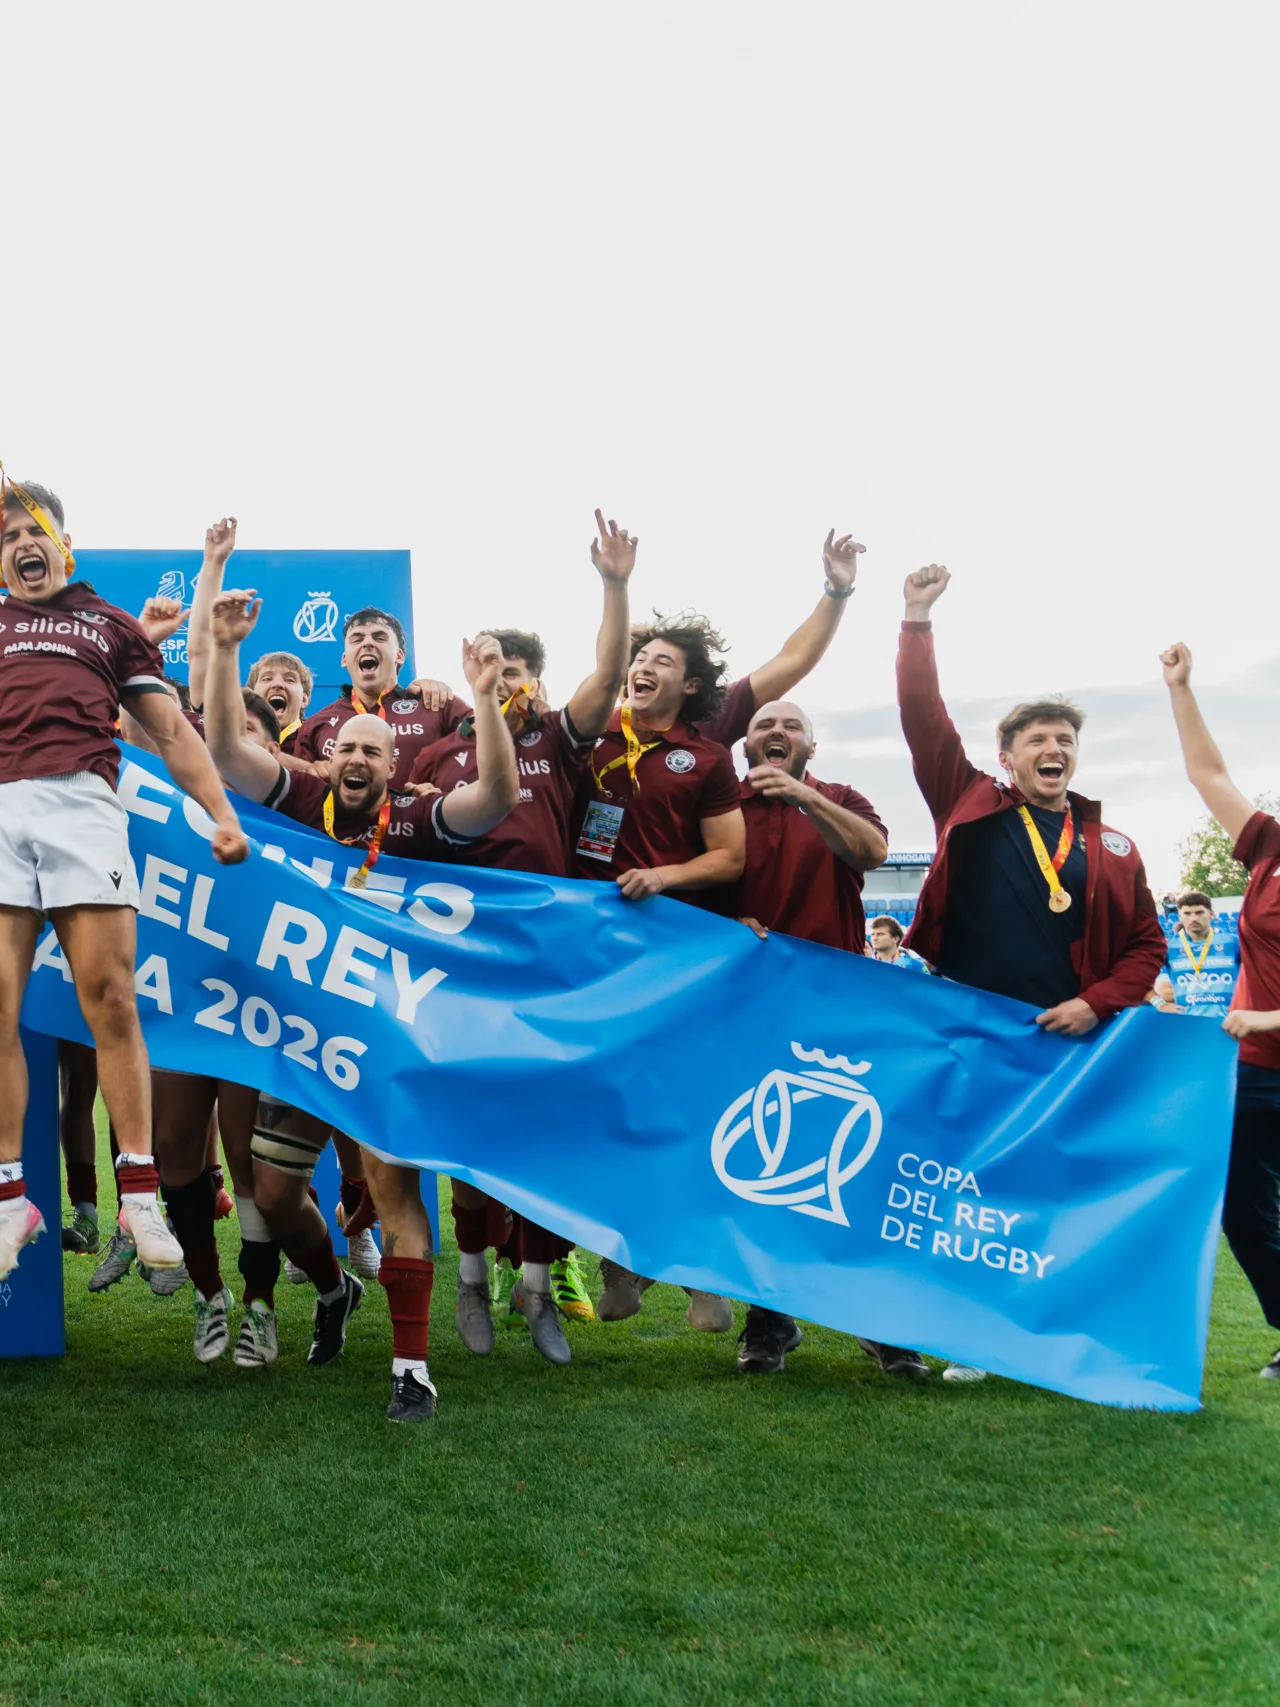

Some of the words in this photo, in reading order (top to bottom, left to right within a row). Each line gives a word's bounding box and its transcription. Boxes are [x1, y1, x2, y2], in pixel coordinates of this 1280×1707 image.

[4, 641, 34, 655] PAPA
[34, 641, 77, 657] JOHNS
[14, 617, 110, 653] silicius
[161, 651, 188, 663] RUG
[137, 852, 230, 953] EL
[255, 900, 449, 1026] REY
[194, 977, 369, 1092] 2026
[897, 1152, 982, 1198] COPA
[887, 1182, 944, 1223] DEL
[954, 1202, 1022, 1237] REY
[880, 1214, 923, 1250] DE
[931, 1230, 1056, 1279] RUGBY
